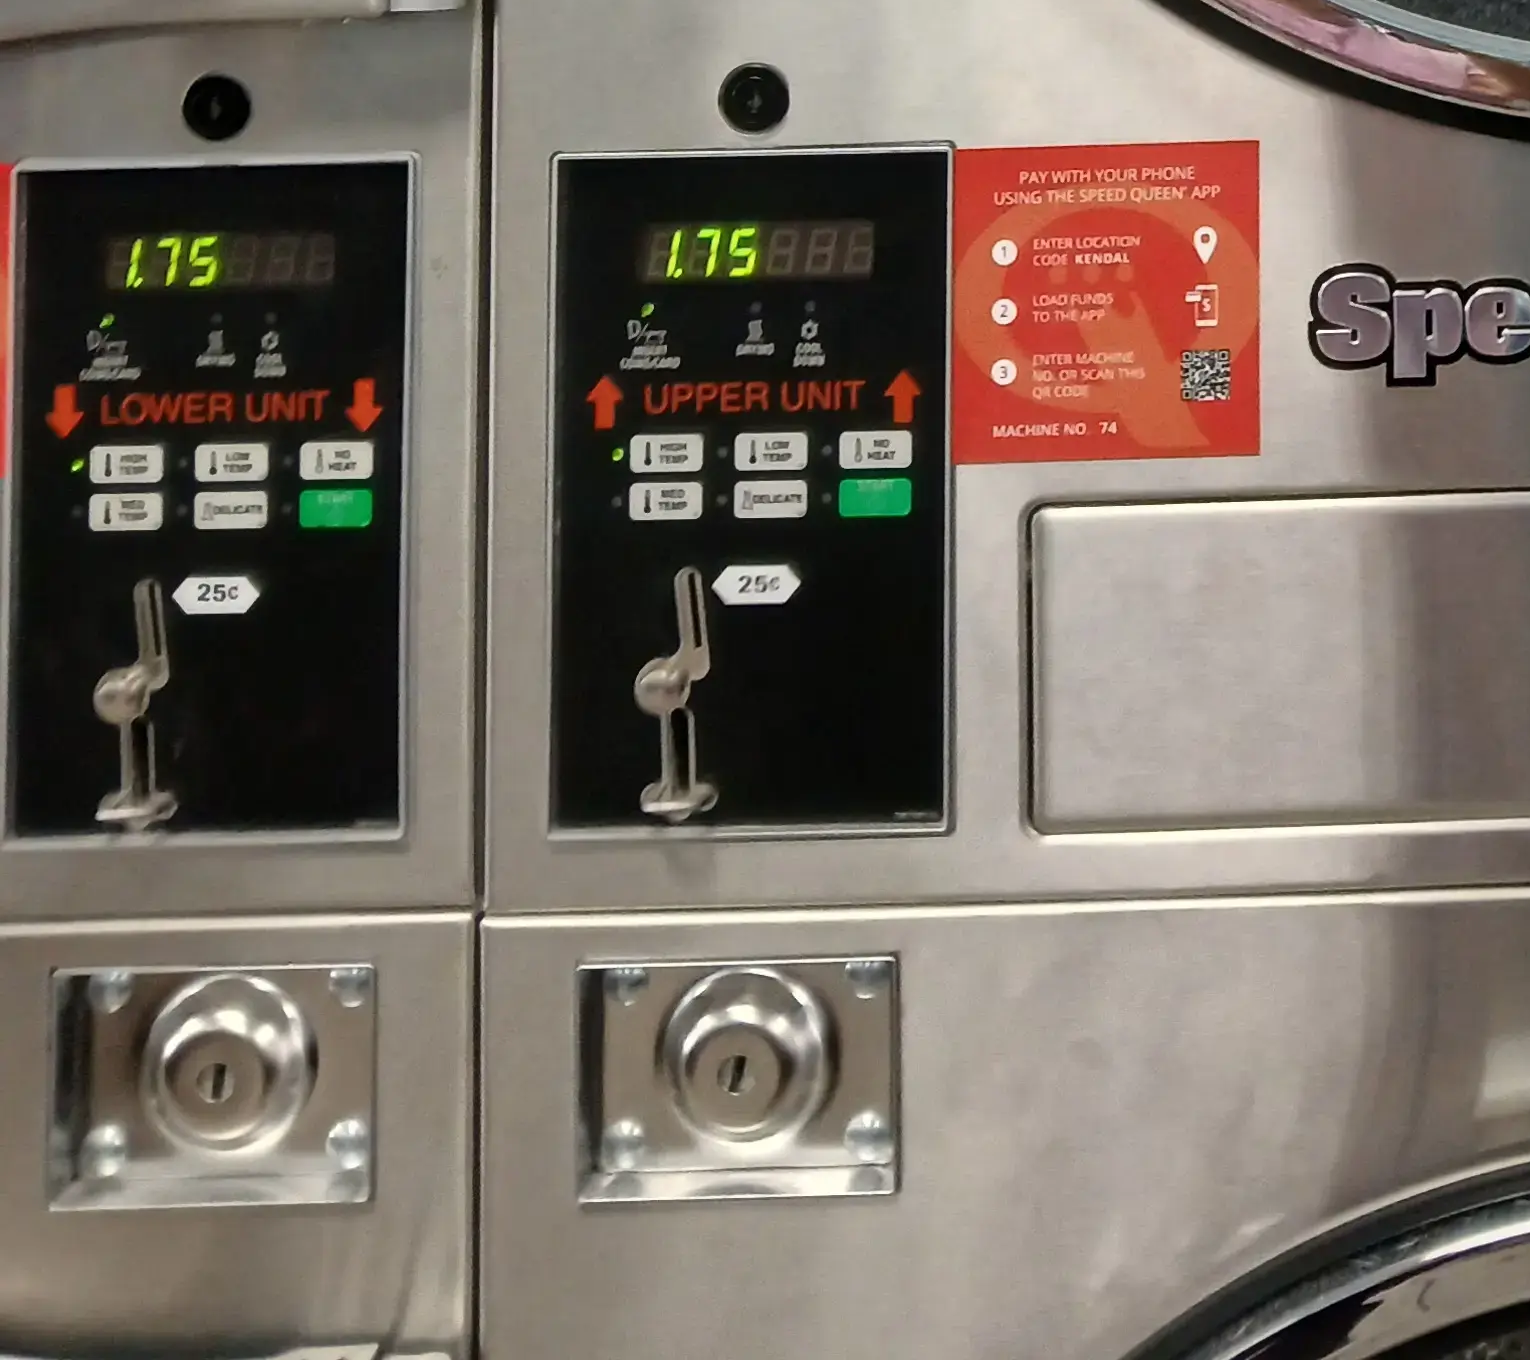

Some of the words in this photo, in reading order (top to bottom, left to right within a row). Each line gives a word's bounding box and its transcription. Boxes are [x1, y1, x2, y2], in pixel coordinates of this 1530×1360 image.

[1019, 170, 1049, 184] PAY
[1052, 169, 1090, 183] WITH
[1095, 168, 1138, 182] YOUR
[1142, 166, 1195, 180] PHONE
[994, 190, 1042, 205] USING
[1047, 189, 1074, 203] THE
[1079, 188, 1126, 202] SPEED
[1191, 185, 1221, 199] APP
[1033, 237, 1072, 249] ENTER
[1076, 236, 1141, 248] LOCATION
[665, 227, 758, 279] 1.75
[1001, 246, 1007, 258] 1
[1033, 254, 1068, 266] CODE
[1075, 252, 1129, 264] KENDAL
[125, 236, 220, 288] 1.75
[1032, 294, 1067, 307] LOAD
[1000, 305, 1009, 318] 2
[1032, 311, 1049, 323] TO
[1000, 366, 1008, 379] 3
[1080, 368, 1114, 380] SCAN
[643, 381, 770, 415] UPPER
[780, 379, 866, 411] UNIT
[100, 392, 235, 427] LOWER
[245, 389, 331, 422] UNIT
[993, 423, 1059, 438] MACHINE
[1098, 421, 1118, 434] 74
